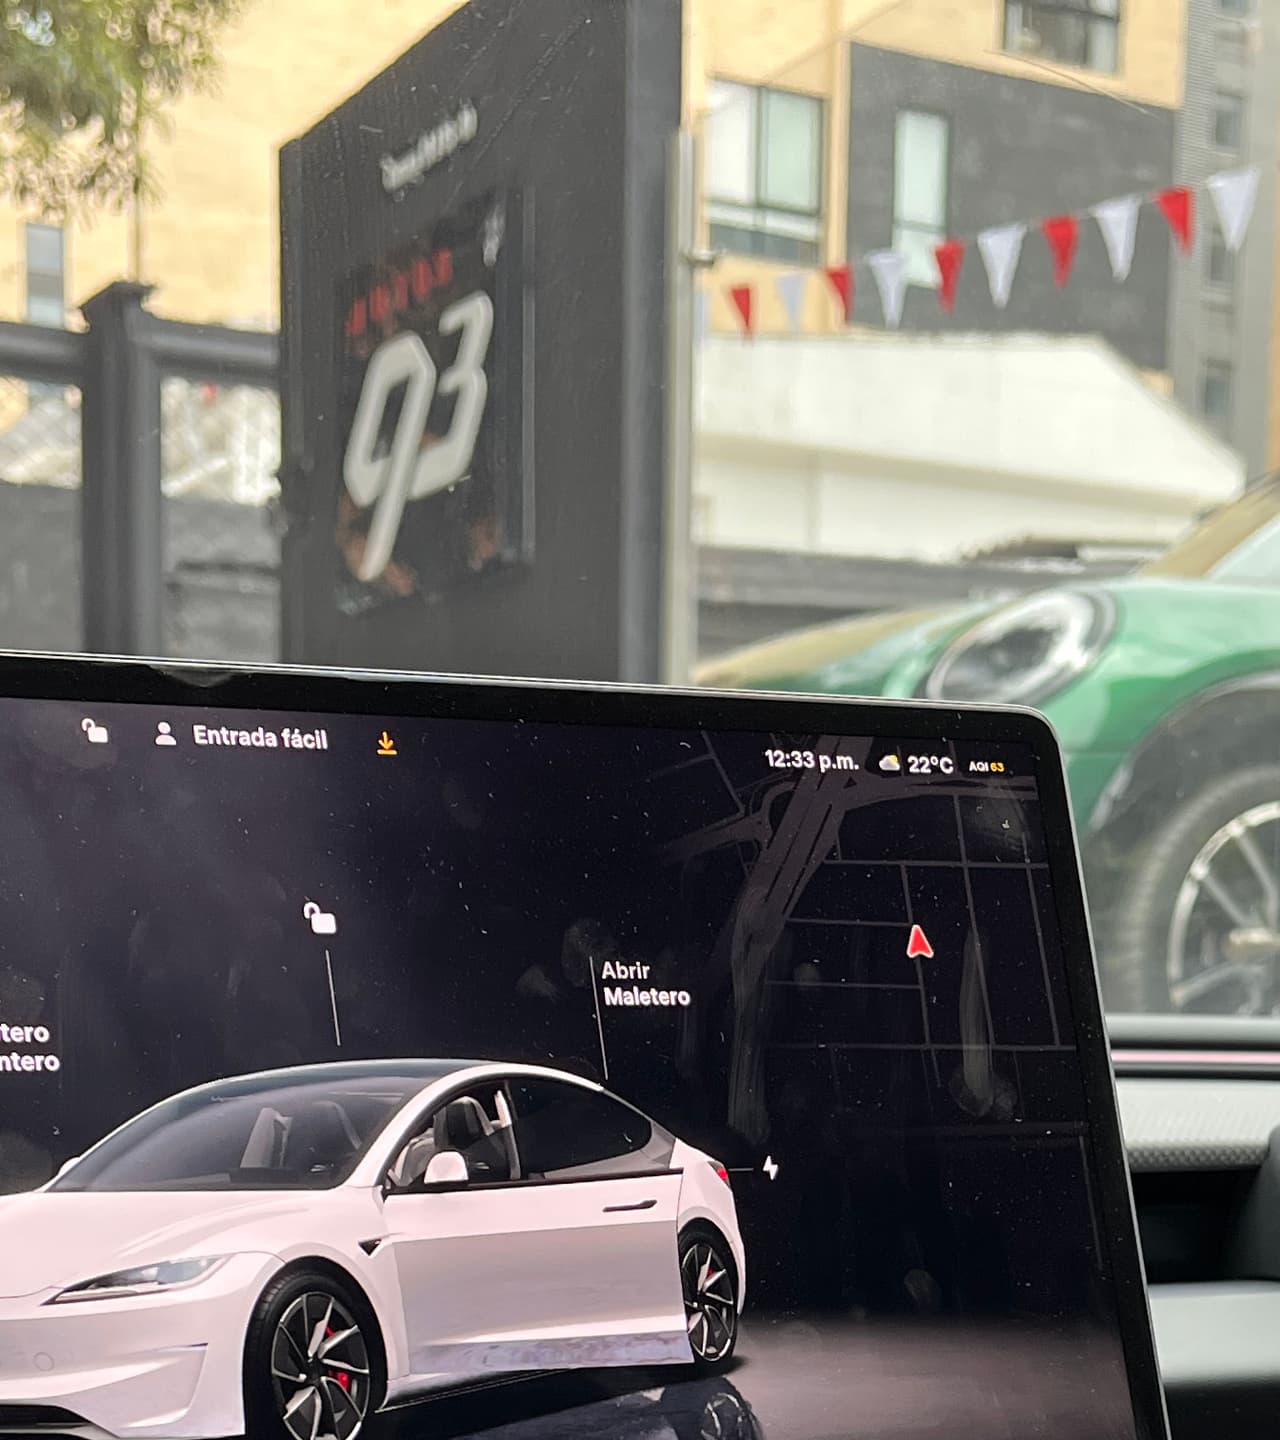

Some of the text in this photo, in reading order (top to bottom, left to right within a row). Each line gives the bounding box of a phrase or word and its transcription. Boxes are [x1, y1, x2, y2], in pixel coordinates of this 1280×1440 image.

[193, 725, 328, 750] Entrada fácil
[764, 749, 860, 773] 12:33 p.m.
[907, 755, 955, 775] 22°C
[990, 761, 1006, 773] 63
[601, 960, 651, 981] Abrir
[603, 986, 691, 1008] Maletero
